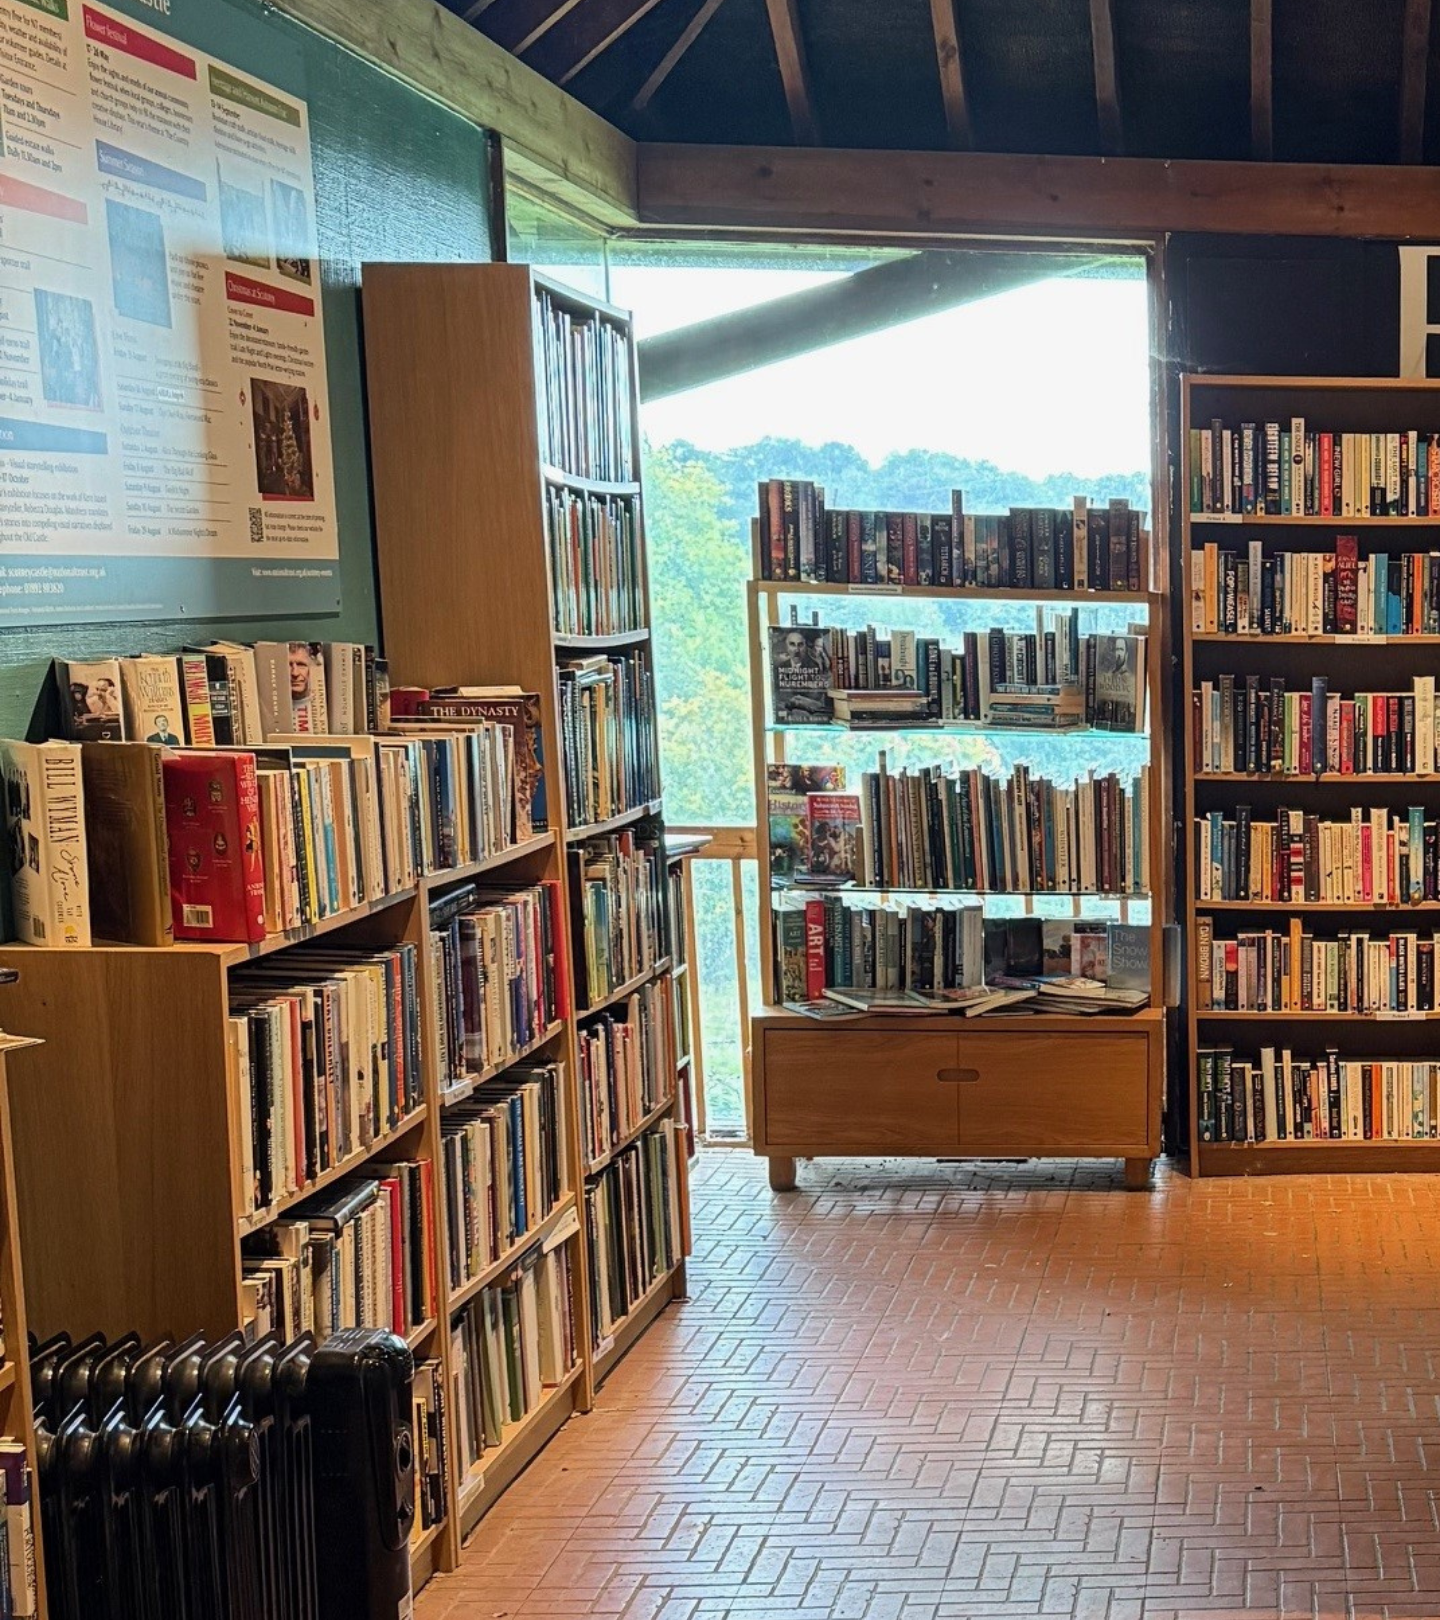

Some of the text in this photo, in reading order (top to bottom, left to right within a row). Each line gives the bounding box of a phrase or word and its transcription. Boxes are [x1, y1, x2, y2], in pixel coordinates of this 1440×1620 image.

[1226, 593, 1236, 625] WEASEL
[779, 680, 830, 688] NUREMBERG
[297, 705, 308, 732] TIM
[431, 705, 519, 717] THE DYNASTY
[45, 758, 76, 789] BILL
[48, 795, 79, 843] WYMAN
[808, 923, 824, 956] ART
[1113, 930, 1135, 941] The
[1113, 944, 1147, 955] Snow
[1199, 926, 1210, 978] DAN BROWN
